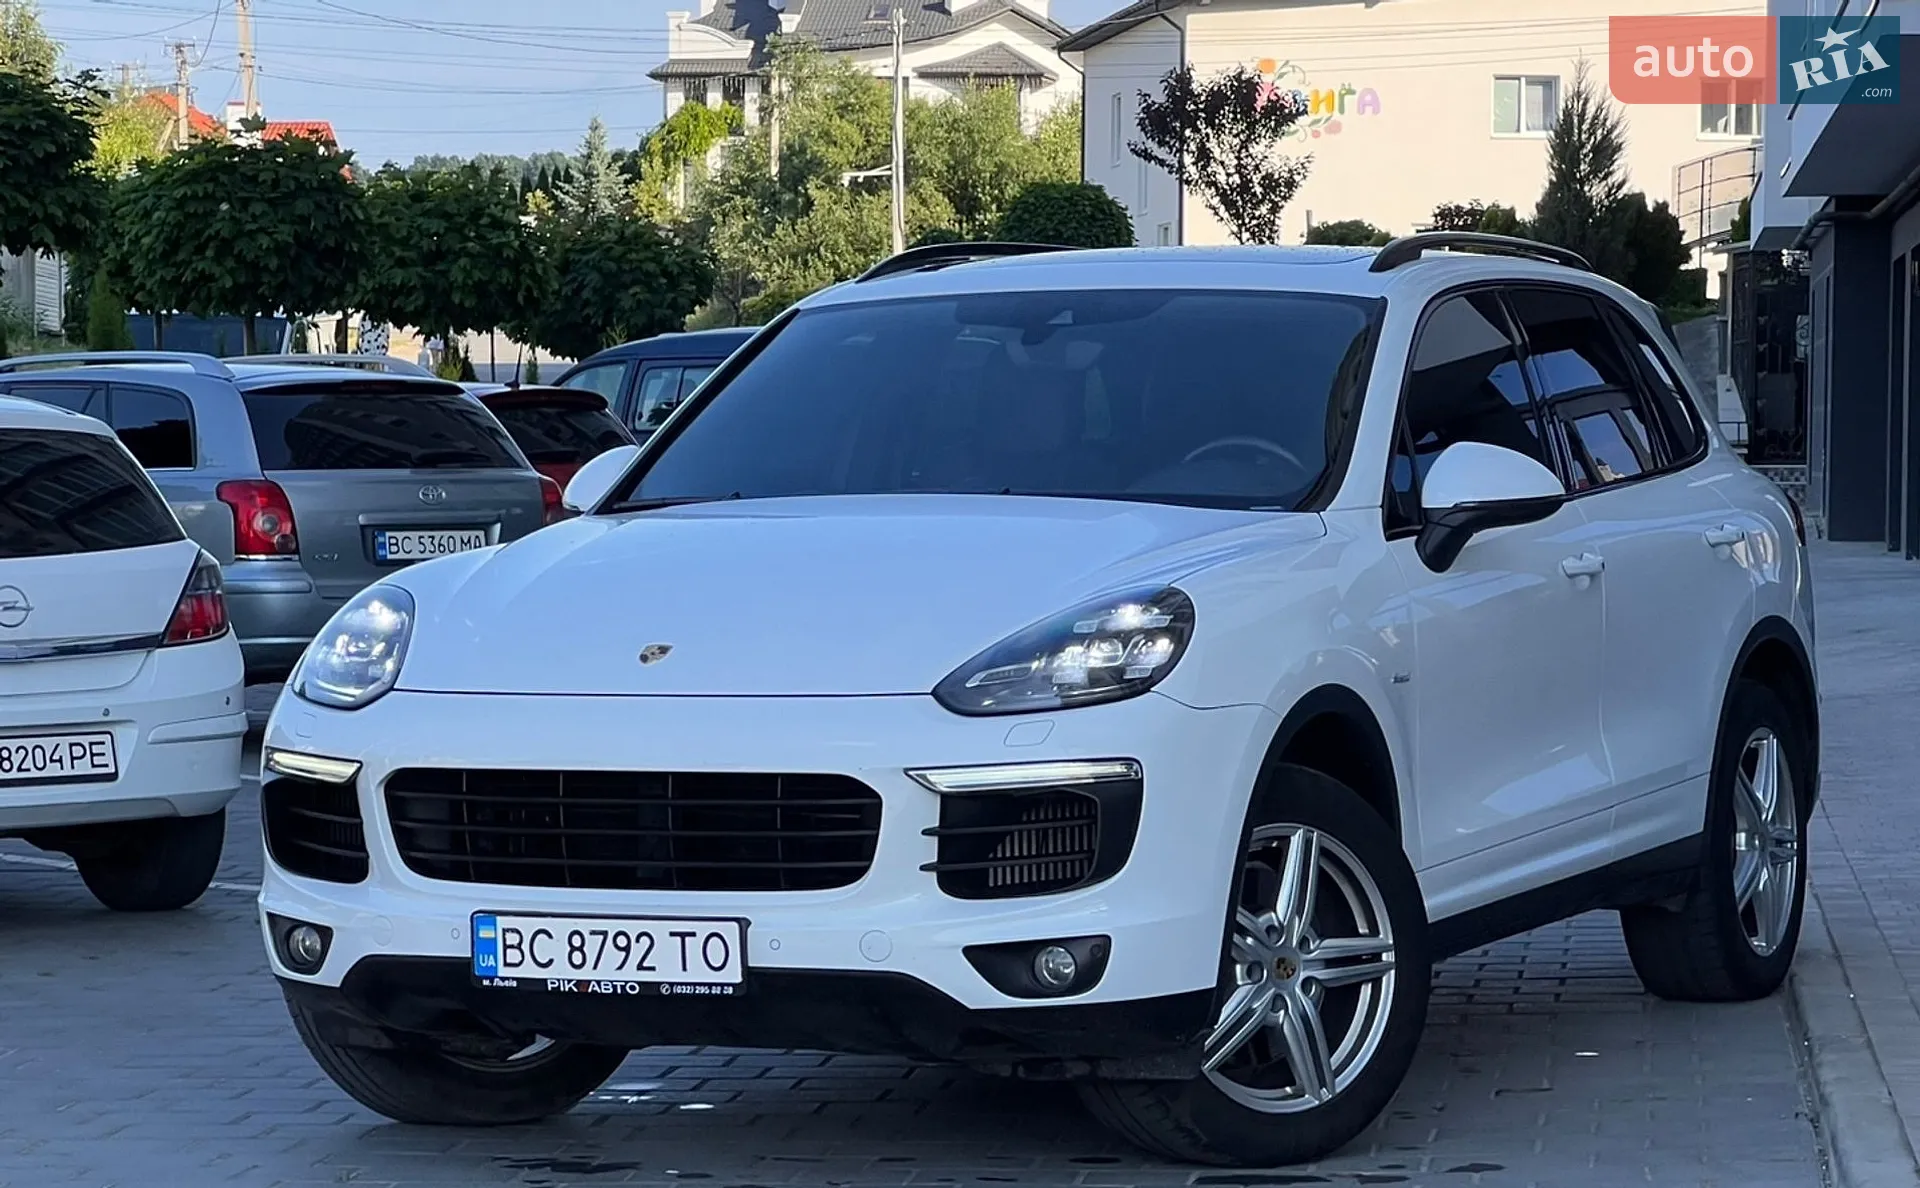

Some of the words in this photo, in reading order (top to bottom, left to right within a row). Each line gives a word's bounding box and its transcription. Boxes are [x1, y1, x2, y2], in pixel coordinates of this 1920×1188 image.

[388, 536, 413, 555] BC
[418, 535, 457, 554] 5360
[460, 535, 482, 552] MA
[502, 927, 555, 969] BC
[567, 929, 656, 972] 8792
[669, 931, 730, 972] TO
[479, 954, 496, 967] UA
